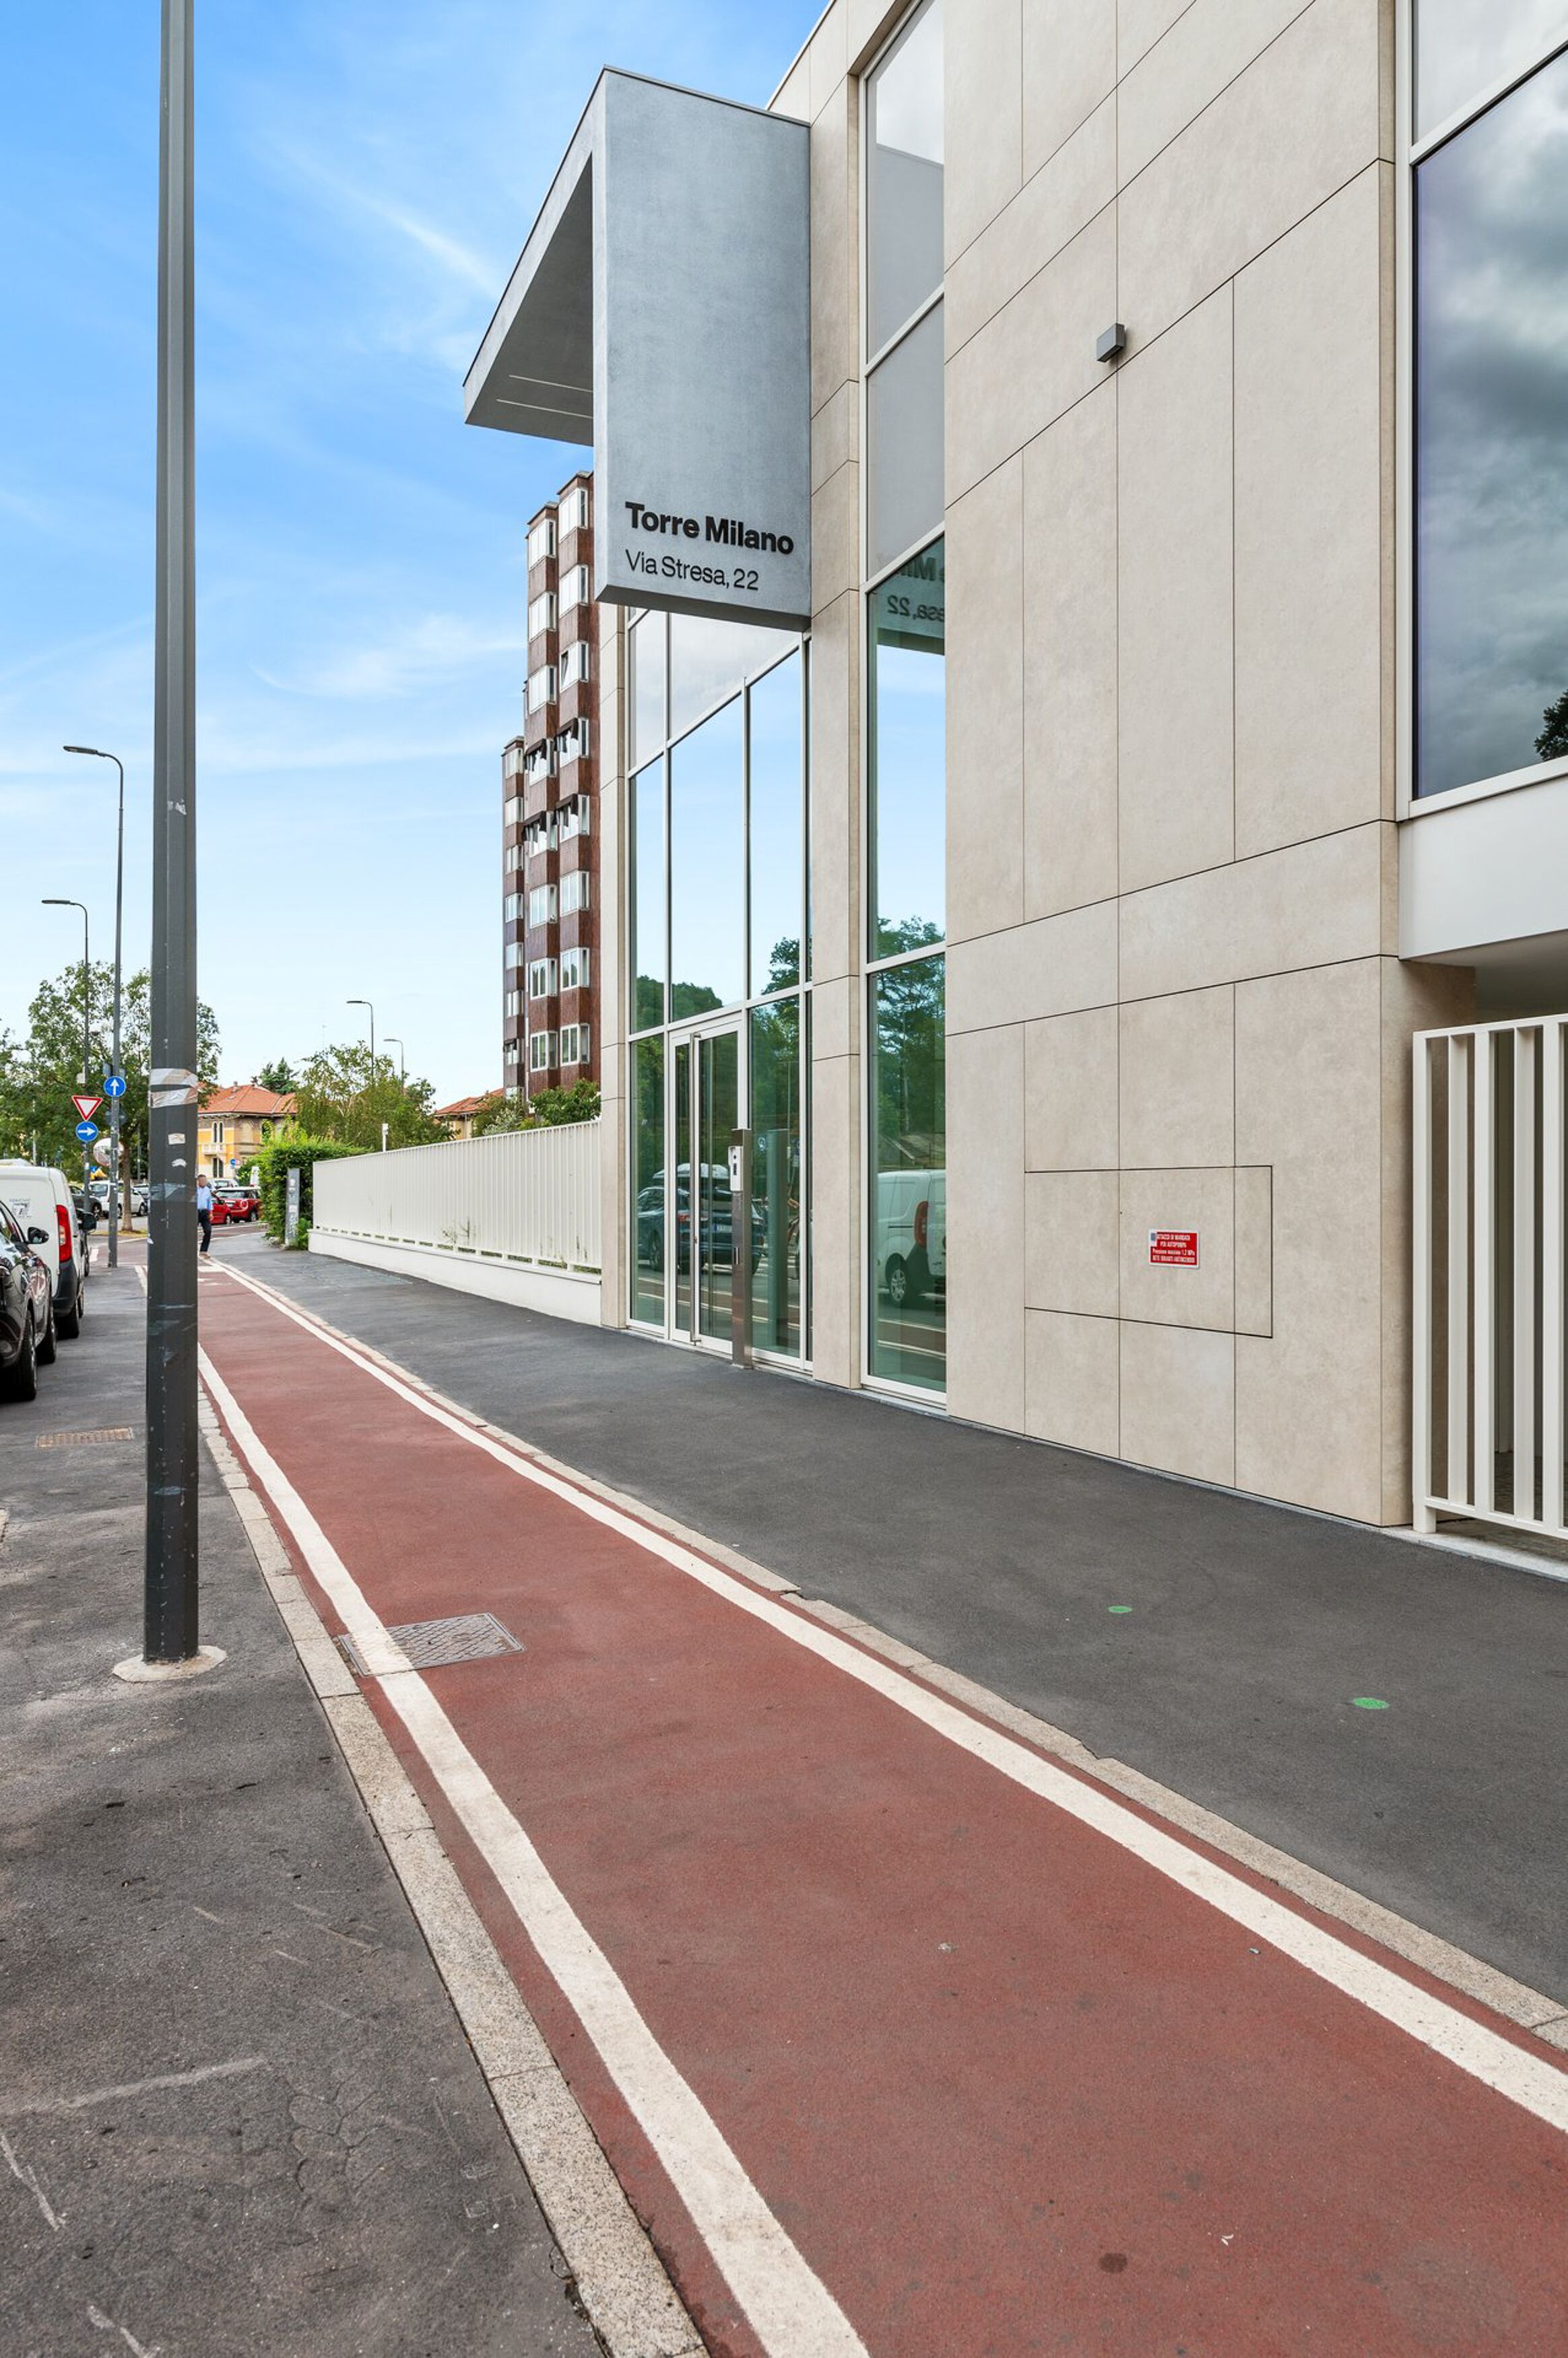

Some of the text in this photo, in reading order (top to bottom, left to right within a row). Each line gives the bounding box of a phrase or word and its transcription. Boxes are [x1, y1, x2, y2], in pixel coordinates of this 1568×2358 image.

[625, 501, 793, 554] Torre Milano
[625, 549, 759, 590] Via Stresa, 22
